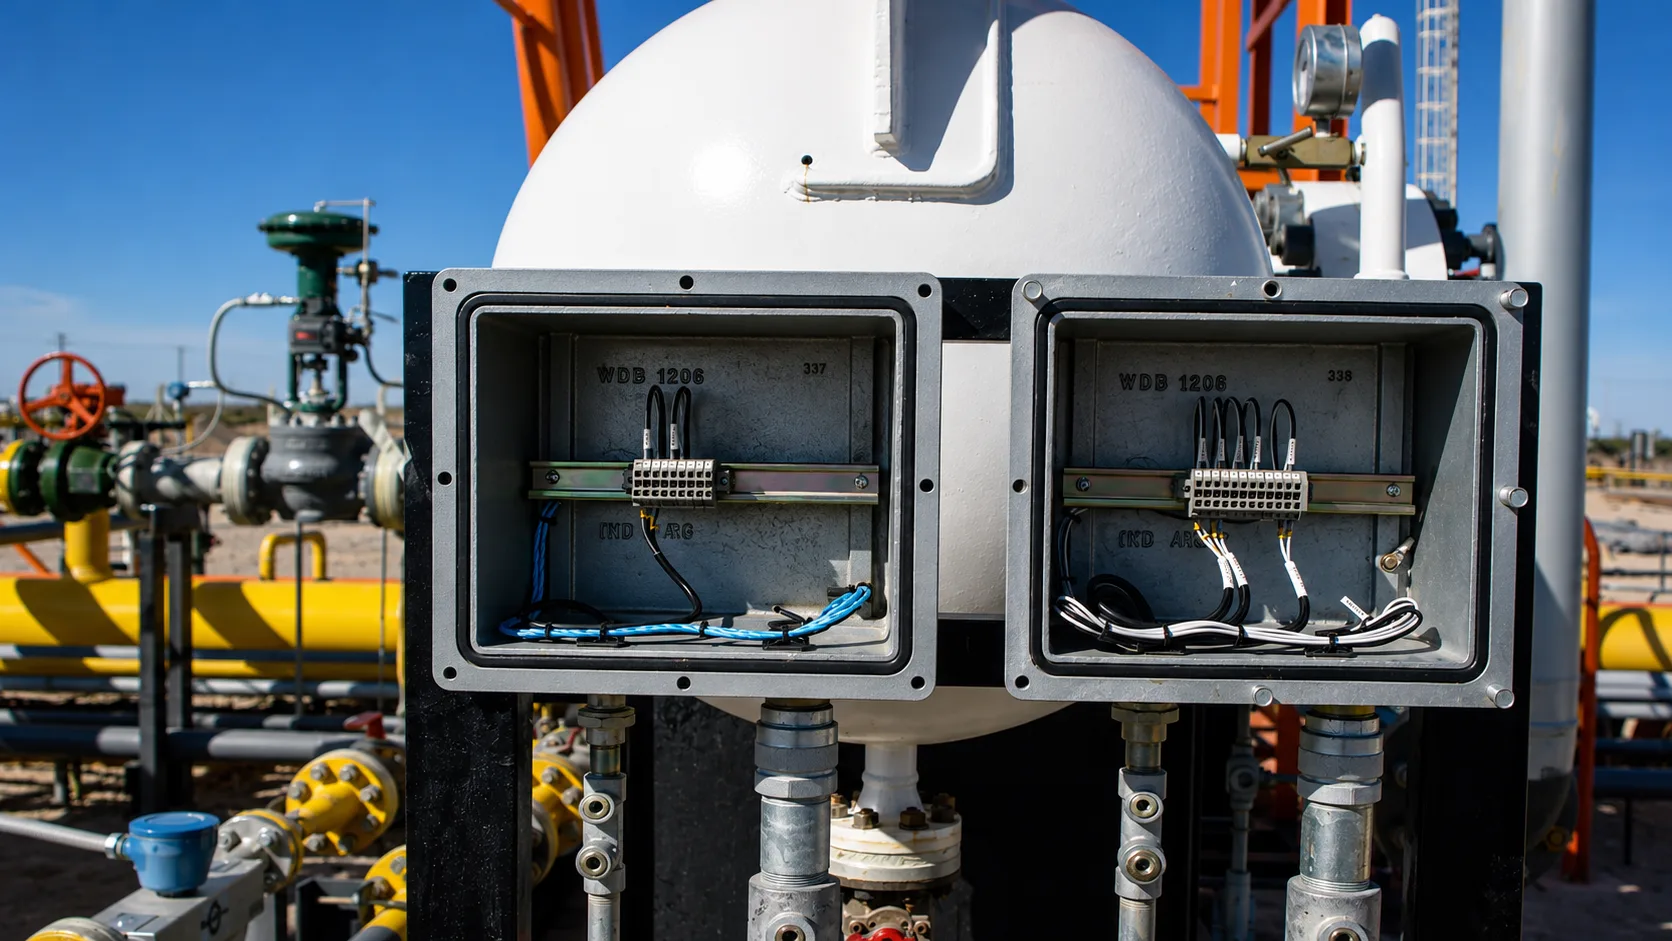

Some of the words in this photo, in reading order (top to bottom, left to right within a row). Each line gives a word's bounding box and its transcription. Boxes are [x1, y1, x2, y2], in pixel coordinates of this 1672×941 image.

[597, 366, 646, 384] WDB
[657, 368, 705, 385] 1206
[803, 363, 827, 374] 337
[1327, 370, 1353, 382] 338
[1119, 373, 1169, 392] WDB
[1178, 374, 1227, 392] 1206
